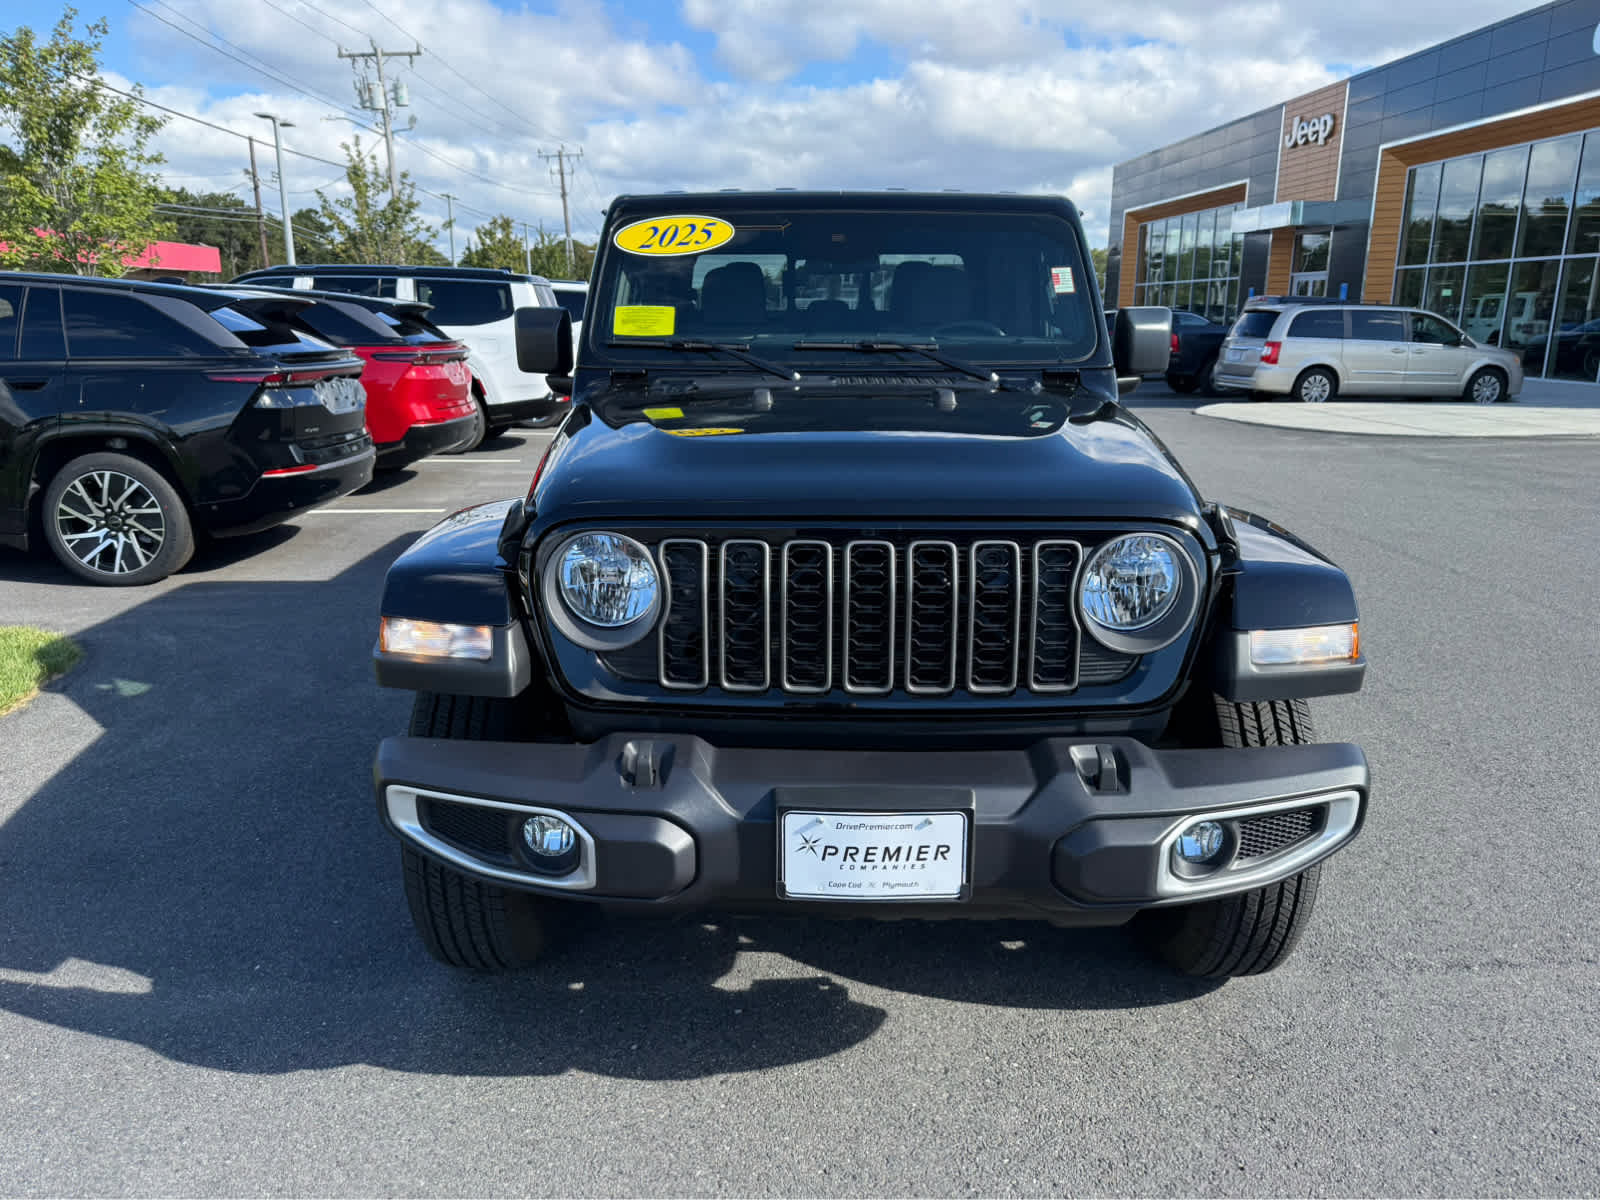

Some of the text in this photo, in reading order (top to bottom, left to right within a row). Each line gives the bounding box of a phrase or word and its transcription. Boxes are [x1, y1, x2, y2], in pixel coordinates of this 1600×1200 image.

[1285, 113, 1334, 148] Jeep
[638, 222, 717, 249] 2025
[835, 822, 913, 831] DrivePremier.com
[821, 844, 951, 863] PREMIER
[839, 863, 926, 871] COMPANIES
[828, 881, 920, 890] Cape Cod Plymouth
